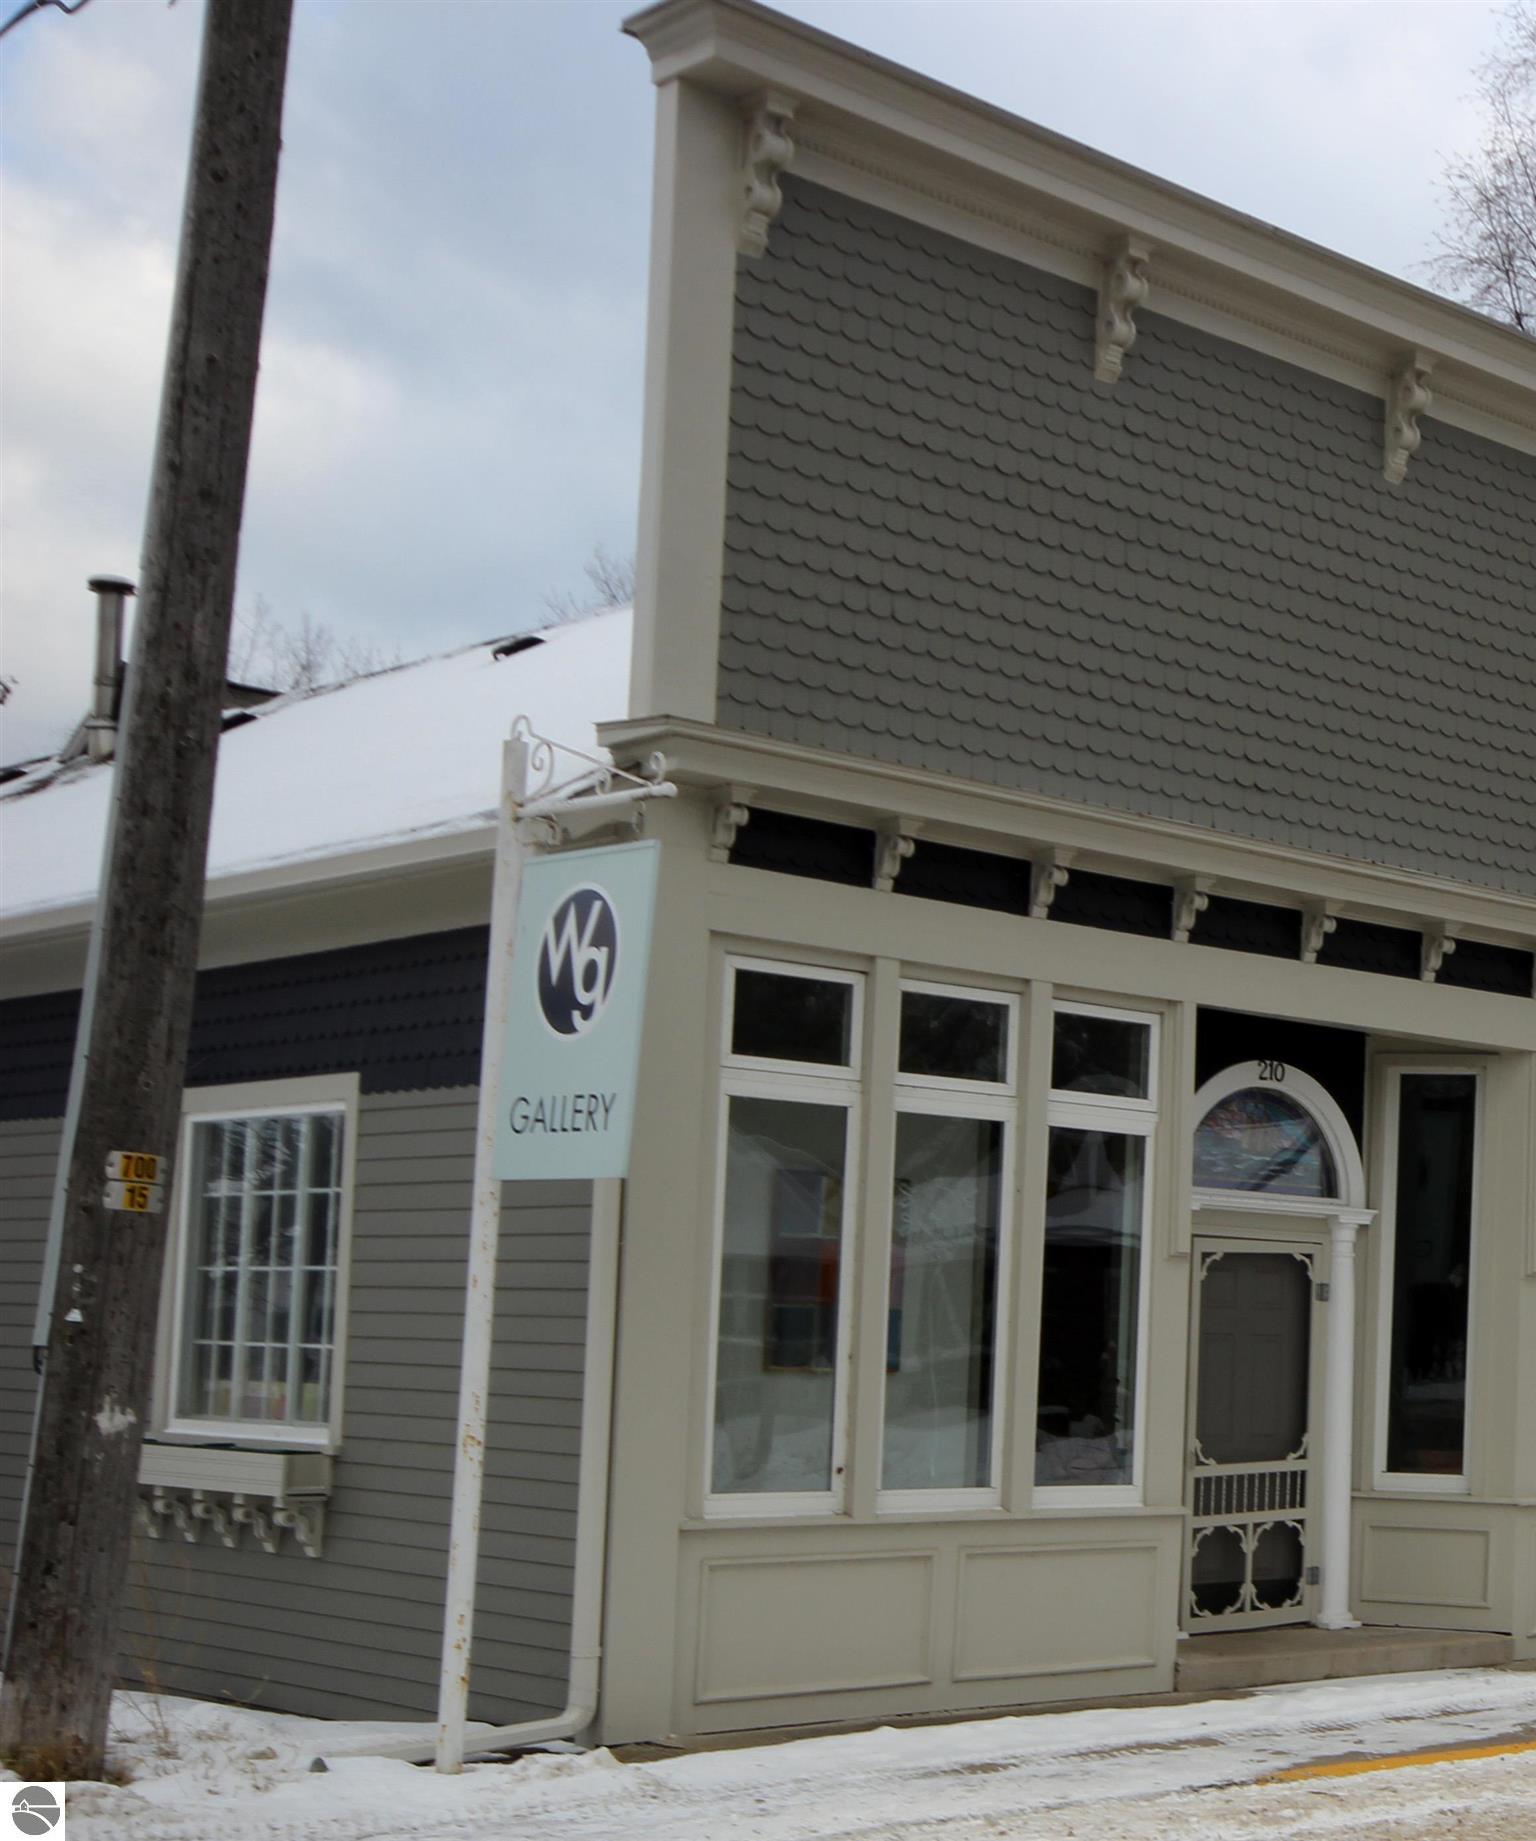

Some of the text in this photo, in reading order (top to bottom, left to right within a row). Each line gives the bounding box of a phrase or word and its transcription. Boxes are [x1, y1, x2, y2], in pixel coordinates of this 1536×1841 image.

[1258, 1060, 1285, 1082] 210
[510, 1092, 617, 1134] GALLERY
[122, 1153, 157, 1180] 700
[126, 1185, 149, 1209] 15
